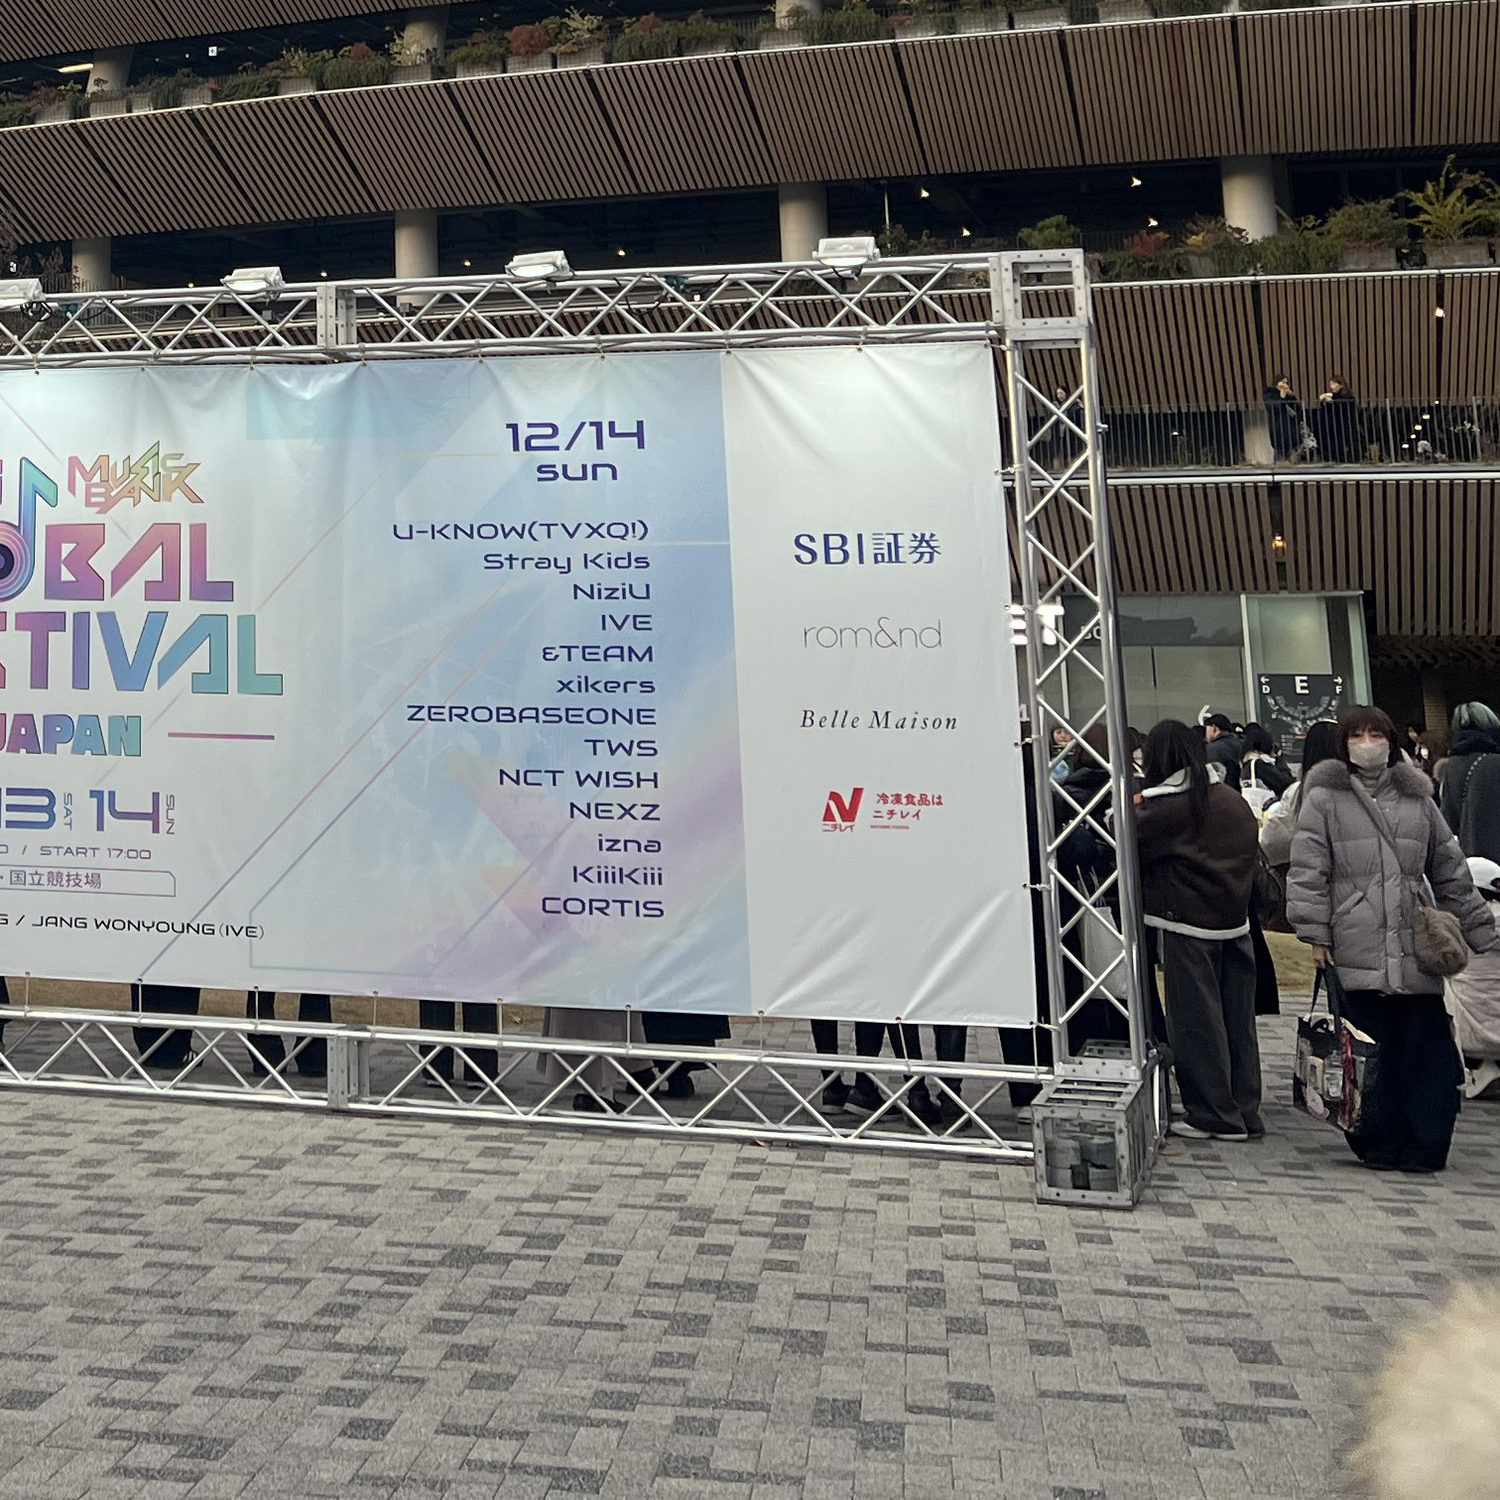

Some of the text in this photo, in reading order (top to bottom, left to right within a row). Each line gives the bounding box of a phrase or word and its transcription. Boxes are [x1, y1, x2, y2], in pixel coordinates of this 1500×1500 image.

[506, 421, 645, 452] 12/14
[537, 461, 618, 482] sun
[393, 521, 649, 542] U-KNOW(TVXQ!)
[483, 552, 651, 574] Stray Kids
[573, 583, 651, 601] NiziU
[602, 614, 652, 631] IVE
[804, 617, 943, 649] rom&nd
[556, 676, 656, 694] xikers
[1262, 685, 1271, 694] D
[1294, 676, 1310, 694] E
[1335, 685, 1343, 695] F
[407, 706, 657, 726] ZEROBASEONE
[800, 710, 958, 731] Belle Maison
[585, 739, 658, 757] TWS
[499, 769, 659, 789] NCT WISH
[876, 792, 943, 806] 冷凍食品は
[63, 792, 73, 830] SAT
[89, 790, 160, 834] 14
[165, 794, 175, 835] SUN
[569, 802, 660, 821] NEXZ
[40, 845, 100, 859] START
[107, 848, 152, 859] 17:00
[597, 834, 661, 853] izna
[573, 866, 663, 886] KiiiKiii
[542, 897, 665, 918] CORTIS
[31, 913, 88, 929] JANG
